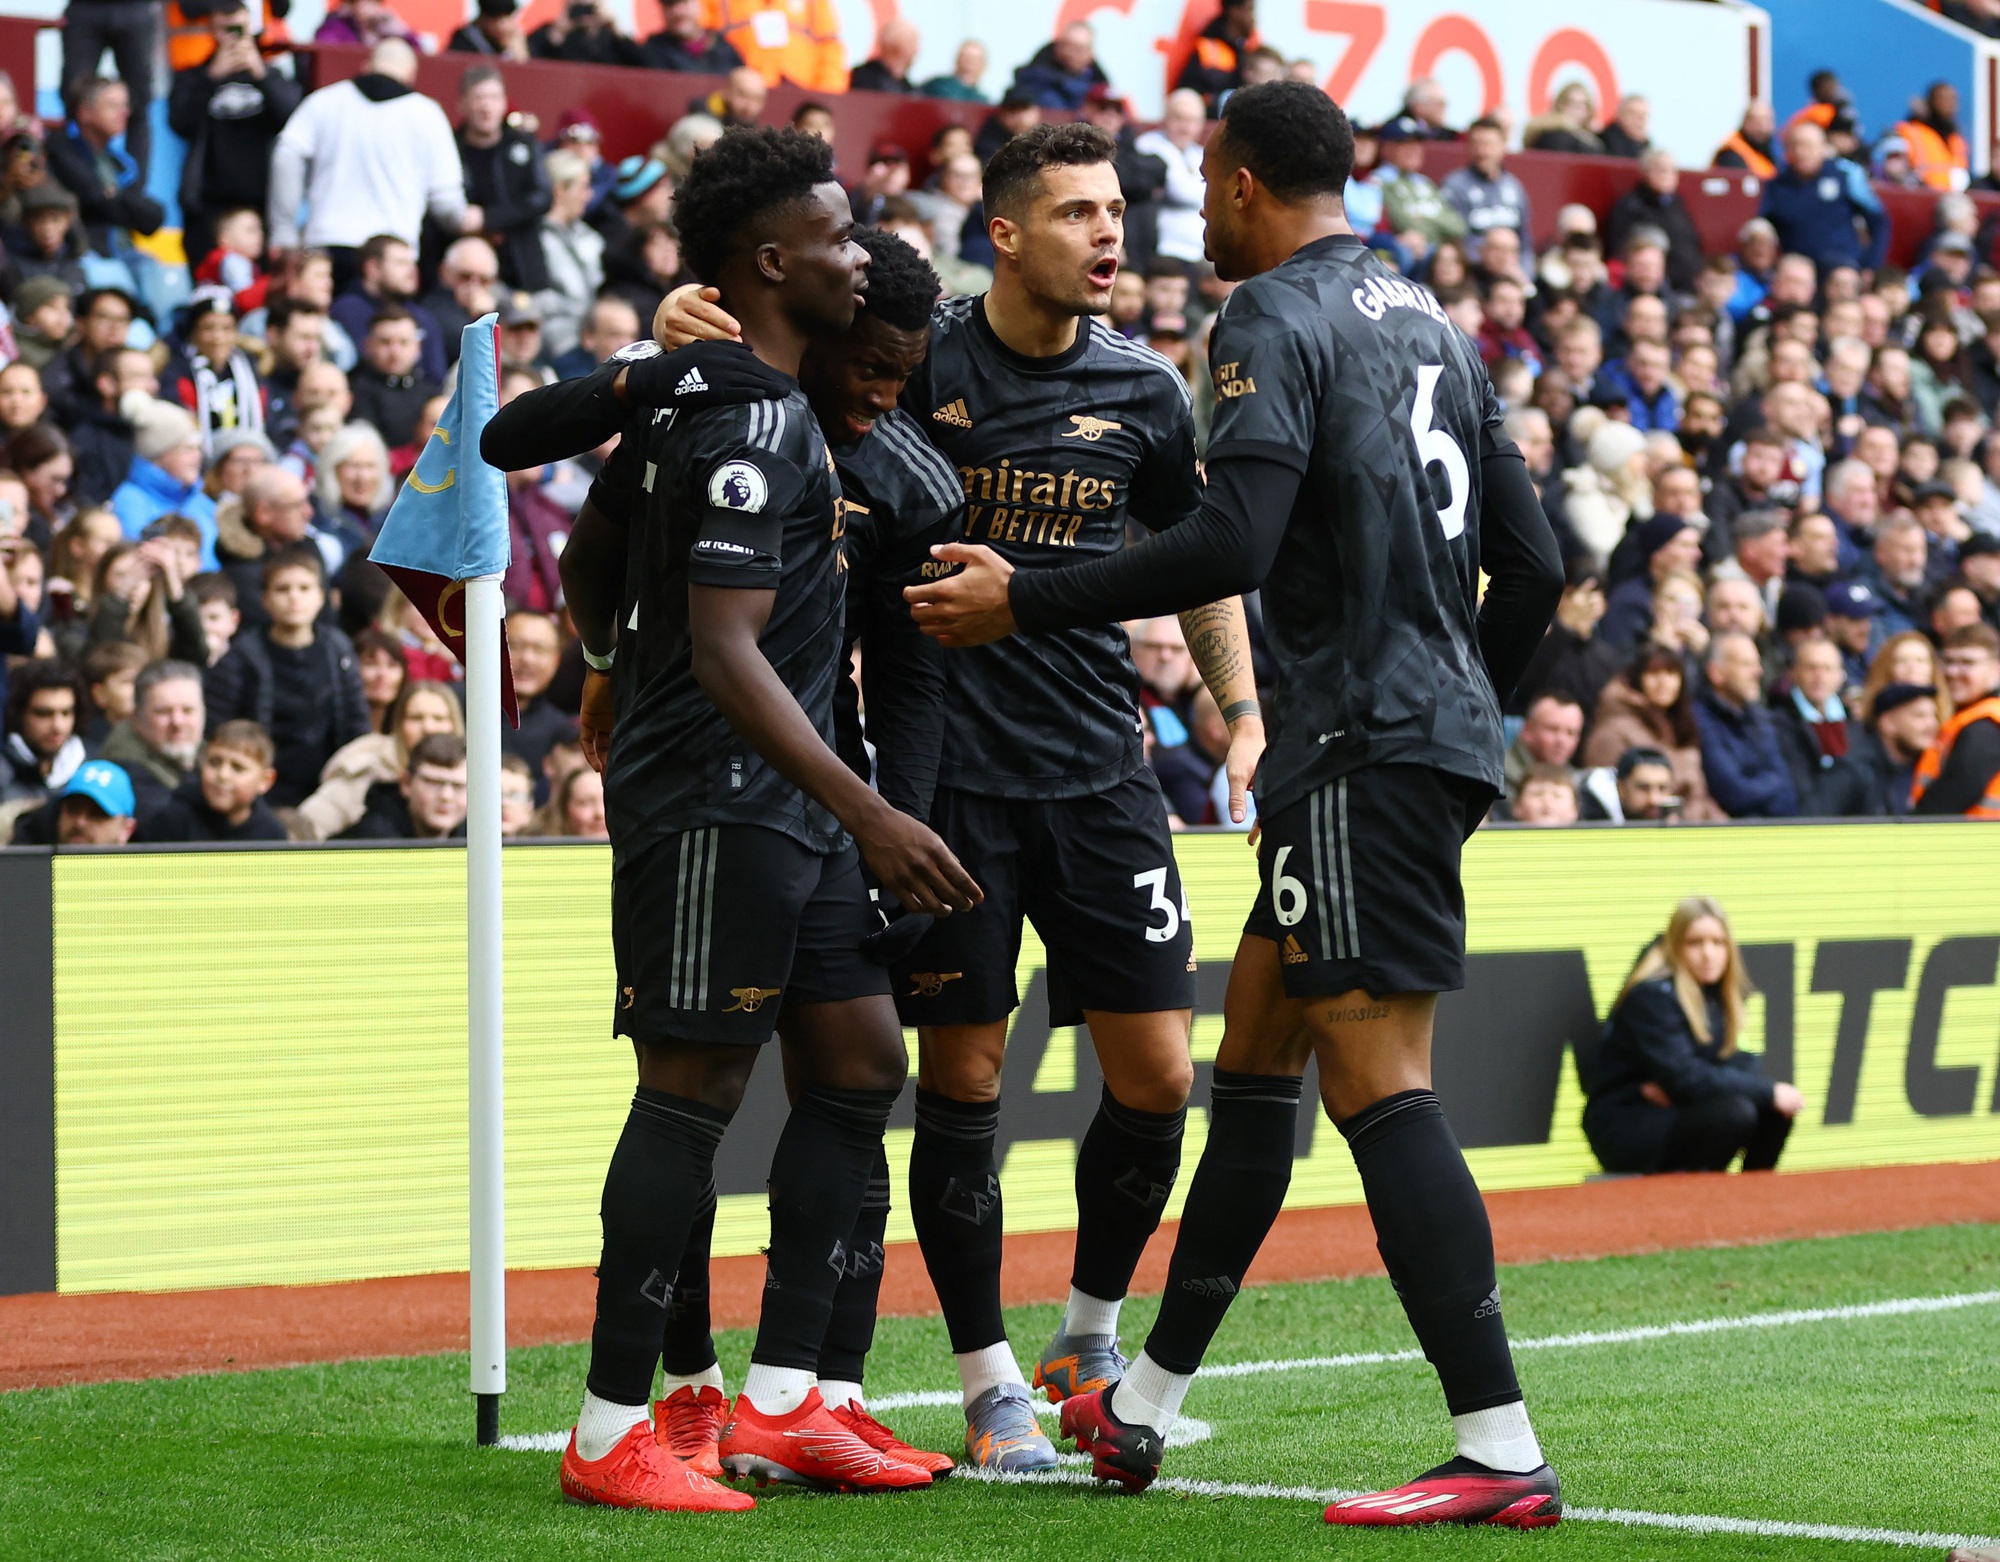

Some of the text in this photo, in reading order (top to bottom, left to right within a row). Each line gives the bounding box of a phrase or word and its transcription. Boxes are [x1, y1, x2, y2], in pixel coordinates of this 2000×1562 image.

[674, 382, 709, 396] adidas
[932, 410, 973, 429] adidas
[1410, 363, 1470, 541] 6
[958, 458, 1116, 511] mirates
[987, 507, 1083, 547] BETTER
[1272, 846, 1308, 926] 6
